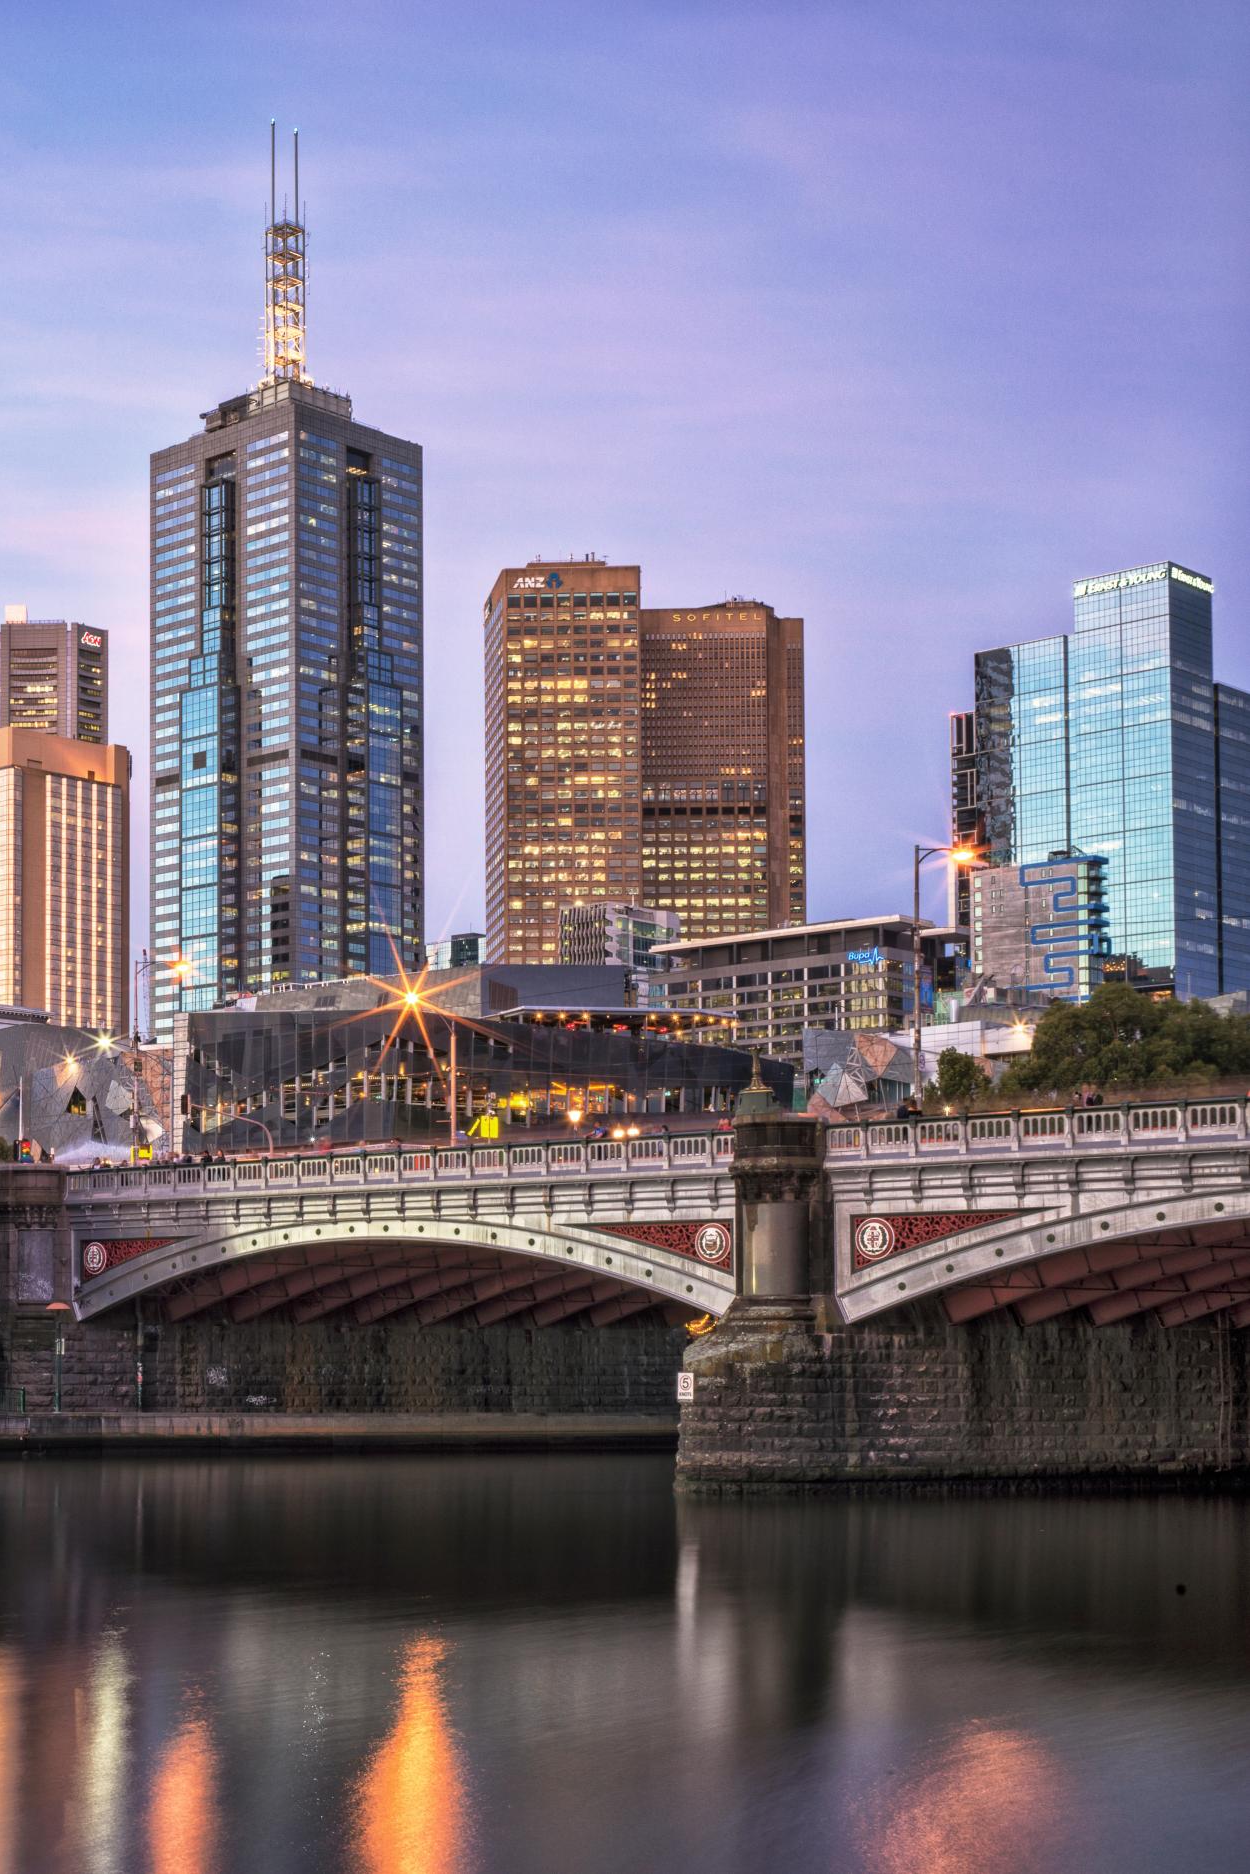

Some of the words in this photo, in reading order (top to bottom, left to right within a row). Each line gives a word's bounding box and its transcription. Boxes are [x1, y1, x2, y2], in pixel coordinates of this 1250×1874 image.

[513, 576, 545, 588] ANZ
[1127, 568, 1167, 586] YOUNG
[672, 612, 762, 622] SOFITEL
[848, 951, 870, 960] Bupa
[682, 1377, 689, 1389] 5
